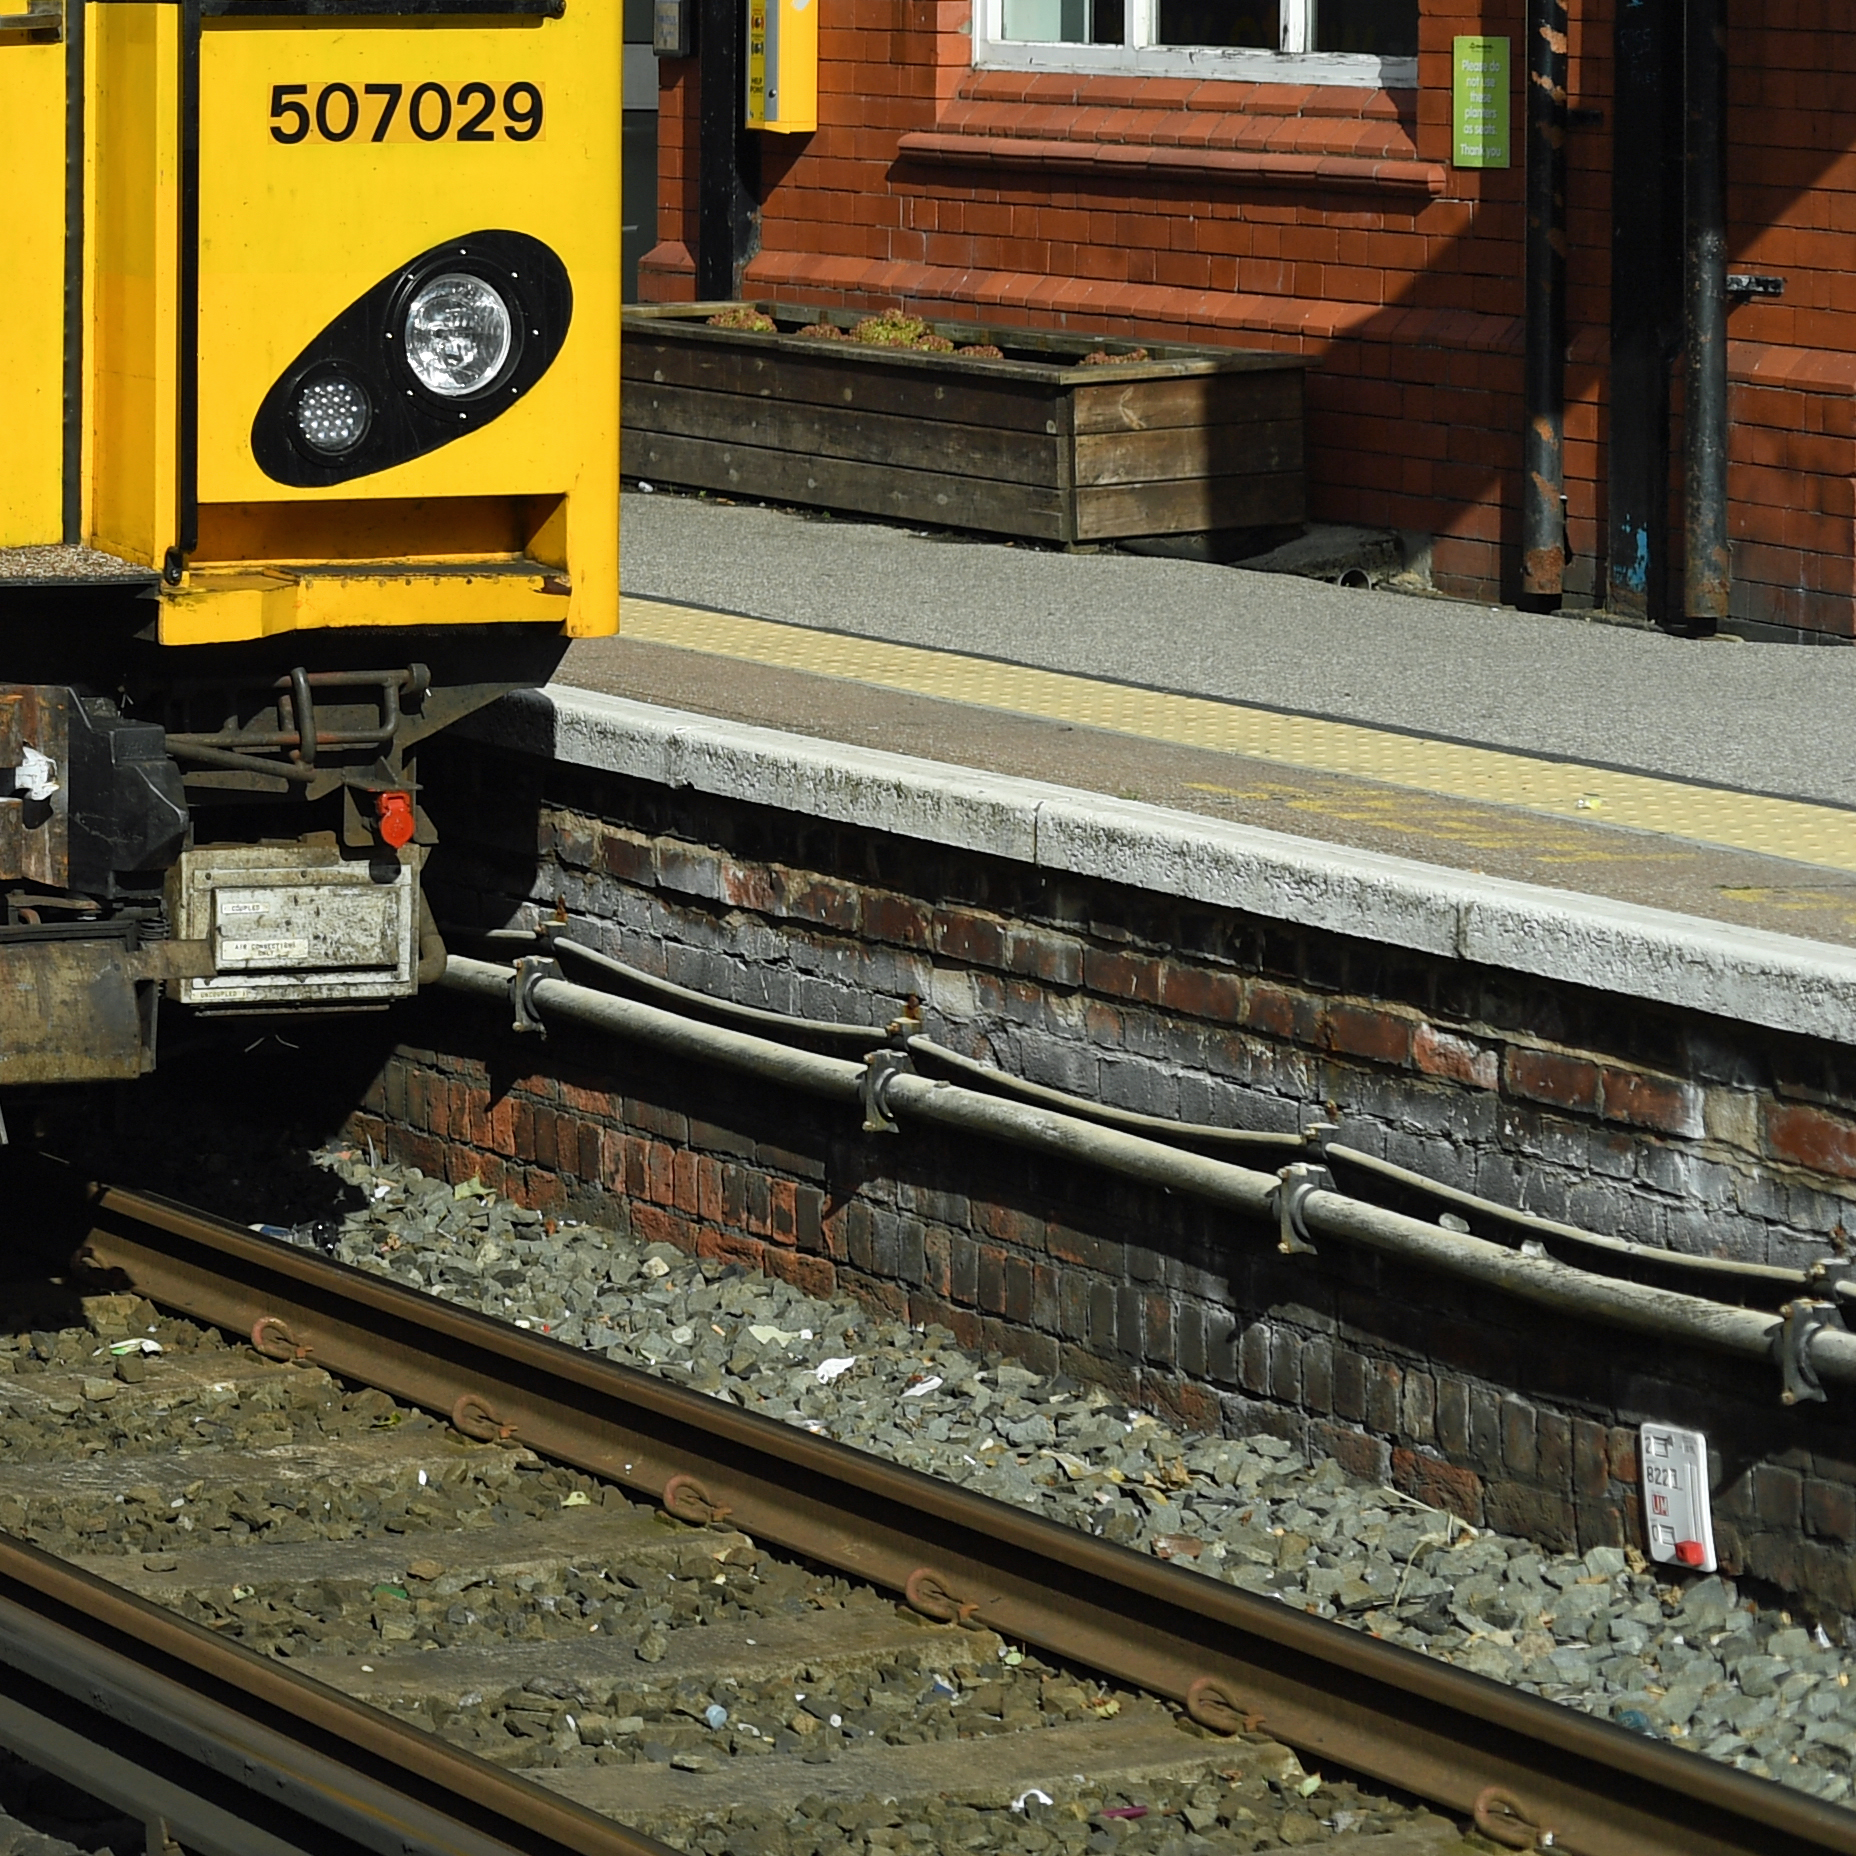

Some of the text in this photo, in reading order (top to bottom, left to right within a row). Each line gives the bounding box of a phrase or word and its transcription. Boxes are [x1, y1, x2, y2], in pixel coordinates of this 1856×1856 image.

[1462, 59, 1501, 72] Please do
[751, 77, 763, 85] HELP
[1466, 77, 1481, 88] not
[750, 85, 764, 94] POINT
[1470, 92, 1492, 103] these
[269, 81, 544, 145] 507029
[1464, 108, 1497, 121] planters
[1463, 124, 1497, 135] as seats.
[1460, 144, 1501, 158] Thank you
